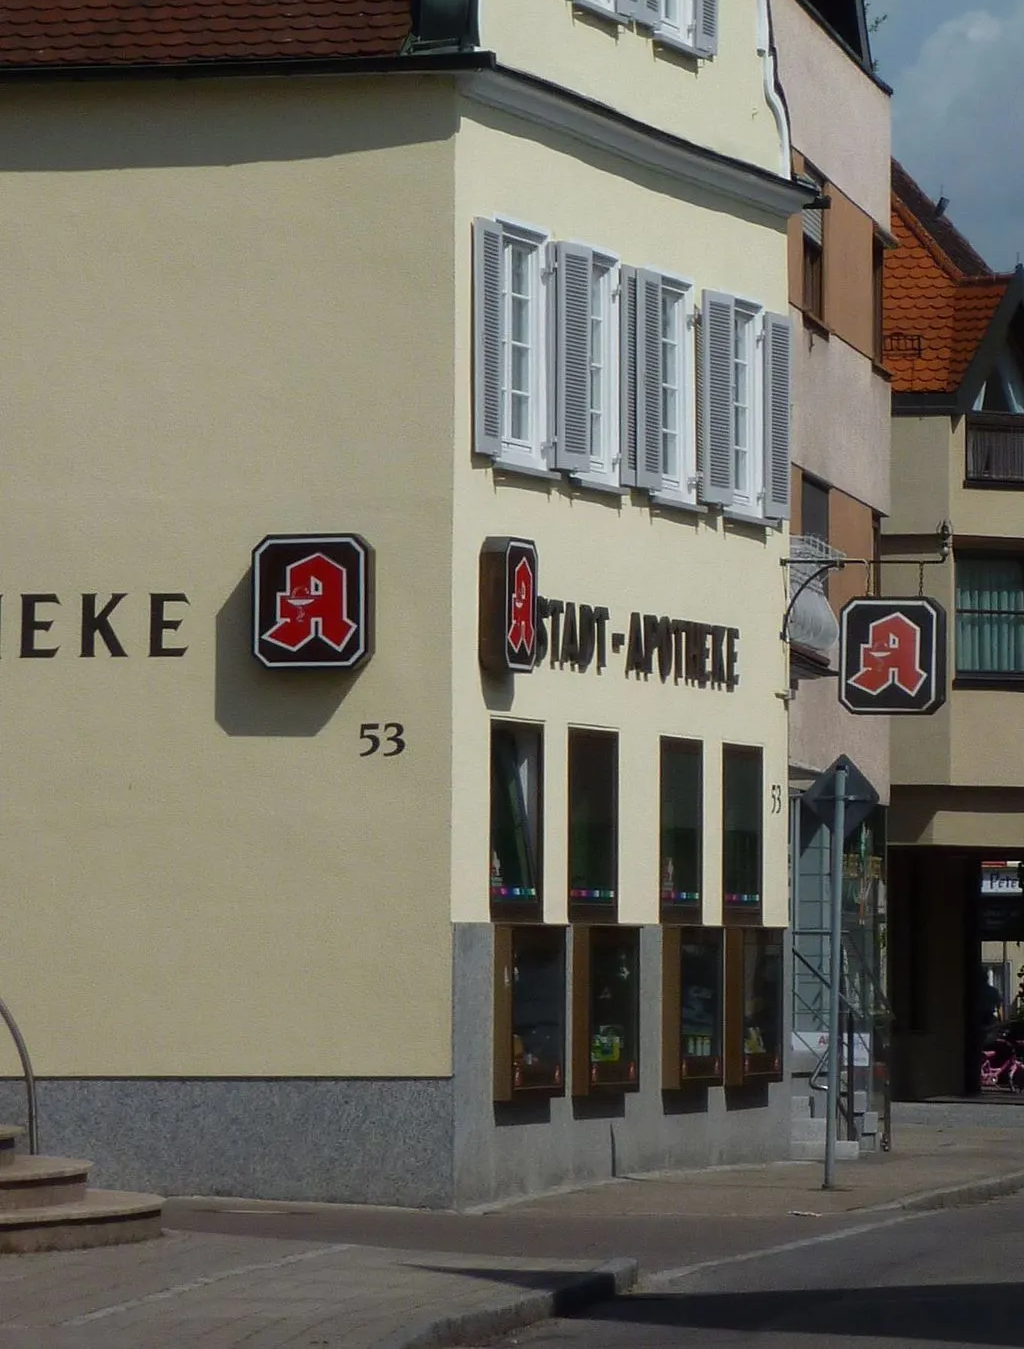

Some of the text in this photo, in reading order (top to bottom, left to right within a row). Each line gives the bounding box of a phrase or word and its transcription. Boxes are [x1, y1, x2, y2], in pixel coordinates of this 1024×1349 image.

[0, 592, 191, 658] EKE
[359, 722, 406, 757] 53
[771, 784, 782, 814] 53
